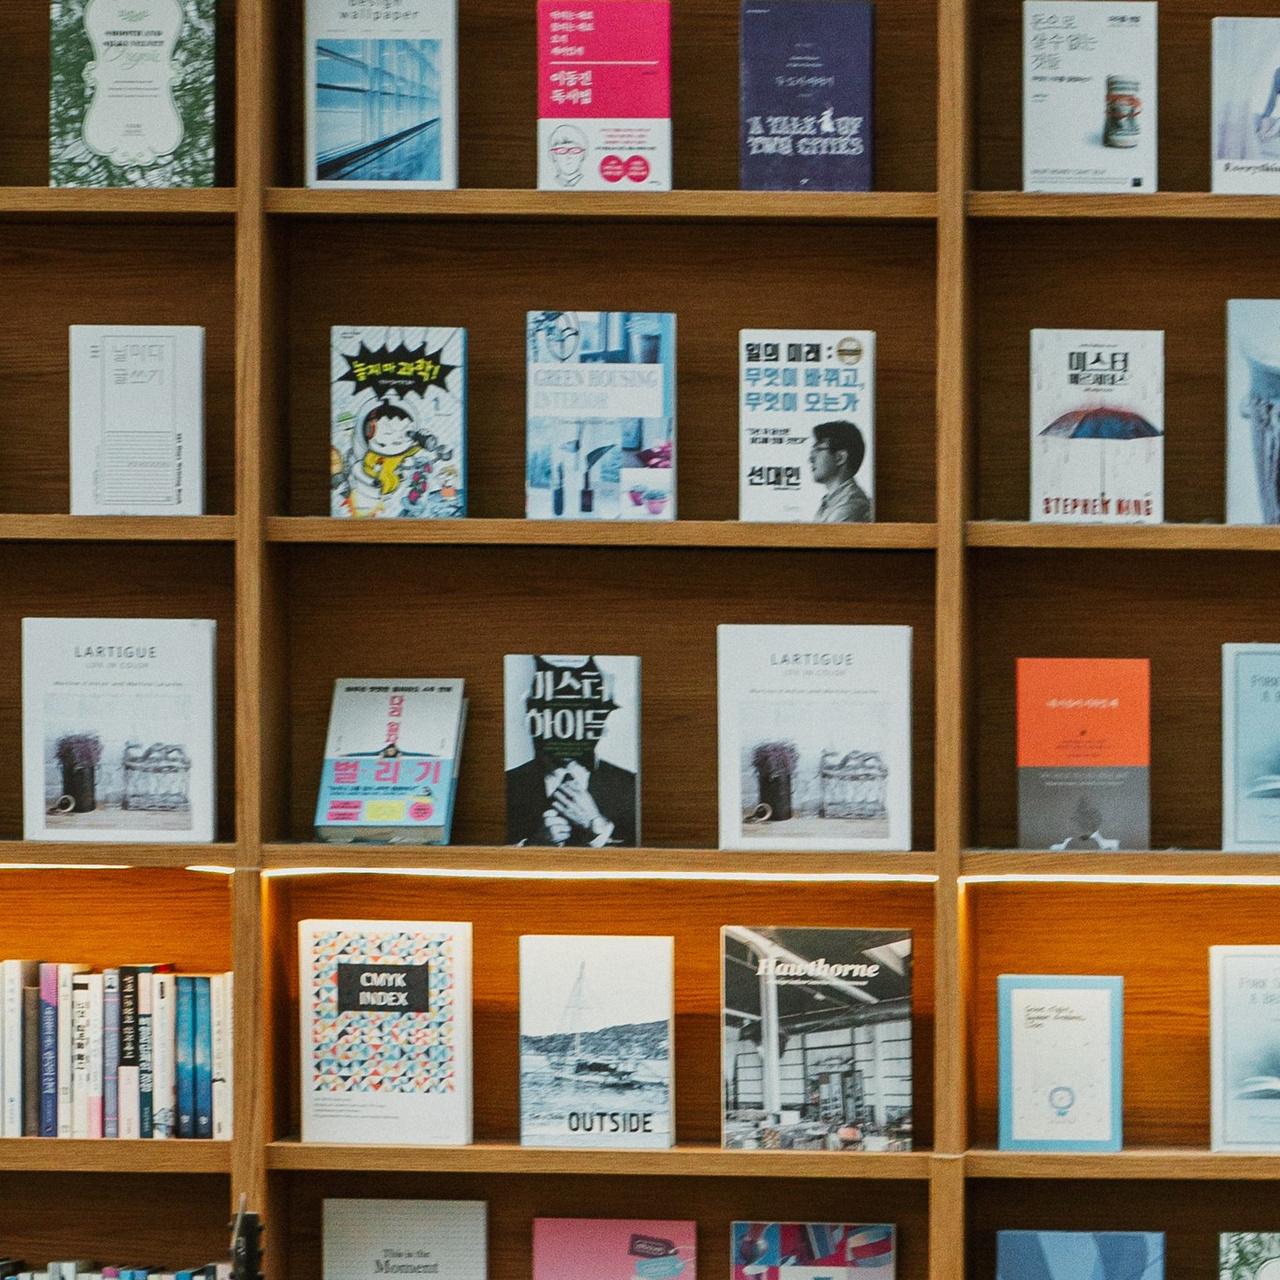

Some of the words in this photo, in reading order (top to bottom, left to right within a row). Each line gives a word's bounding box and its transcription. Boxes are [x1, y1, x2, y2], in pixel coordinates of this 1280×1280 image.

[339, 9, 419, 21] wallpaper
[787, 342, 821, 363] 미래
[1067, 351, 1130, 372] 미스터
[532, 368, 584, 388] GREEN
[747, 466, 801, 486] 선대인
[1042, 496, 1109, 515] STEPHEN
[1116, 497, 1153, 516] KING
[74, 646, 158, 659] LARTIGUE
[769, 652, 855, 667] LARTIGUE
[756, 957, 880, 978] Hawthorne
[359, 972, 408, 987] CMYK
[359, 991, 409, 1006] INDEX
[568, 1112, 653, 1133] OUTSIDE
[374, 1260, 440, 1274] Moment
